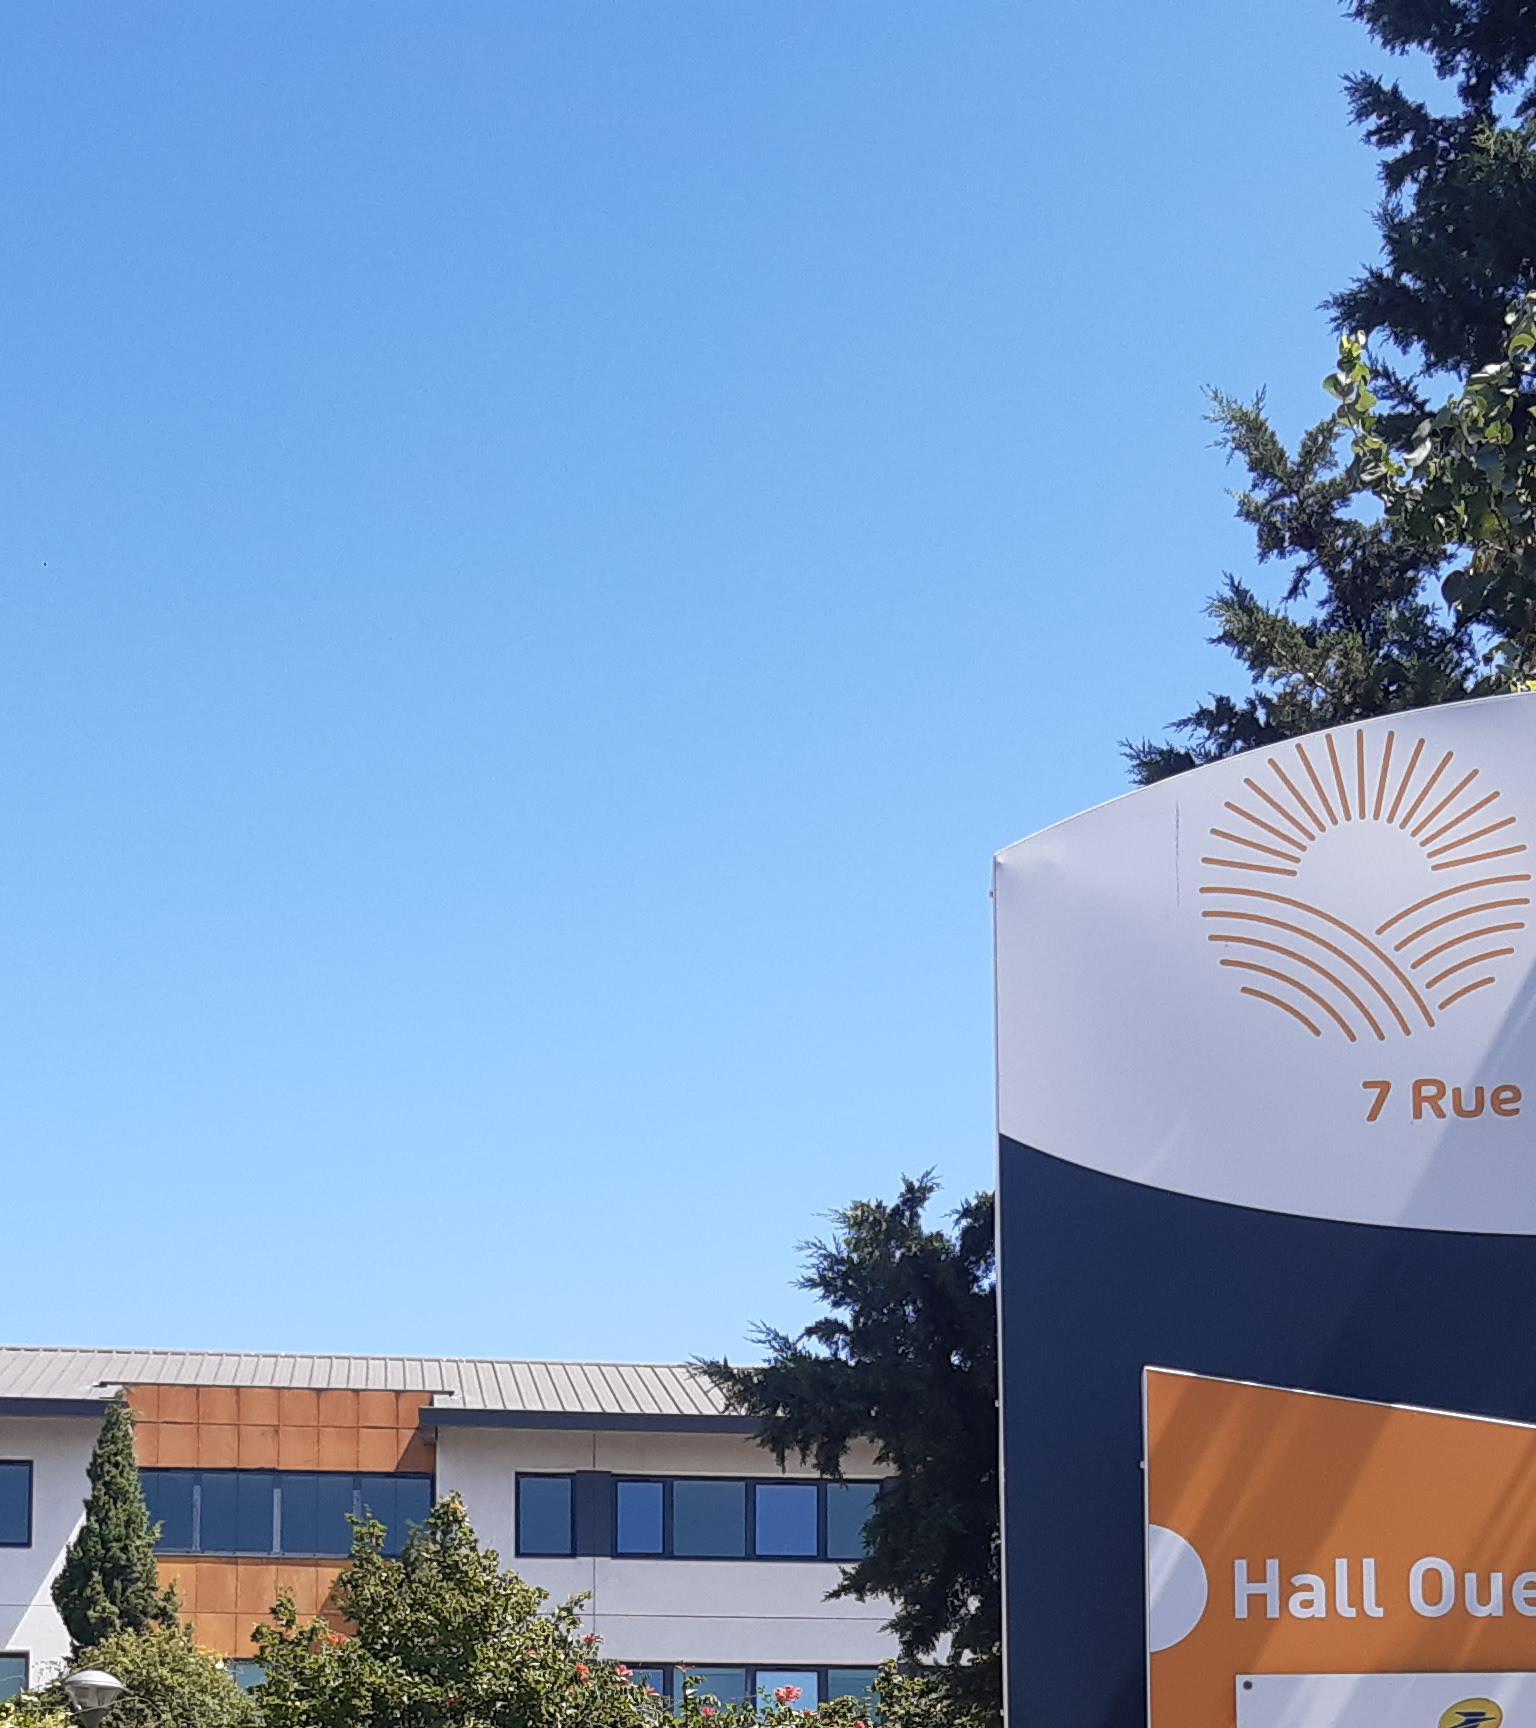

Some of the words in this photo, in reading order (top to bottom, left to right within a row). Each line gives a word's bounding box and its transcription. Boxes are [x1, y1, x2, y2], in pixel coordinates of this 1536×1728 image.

[1361, 1077, 1392, 1124] 7
[1411, 1075, 1522, 1123] Rue
[1233, 1556, 1384, 1620] Hall
